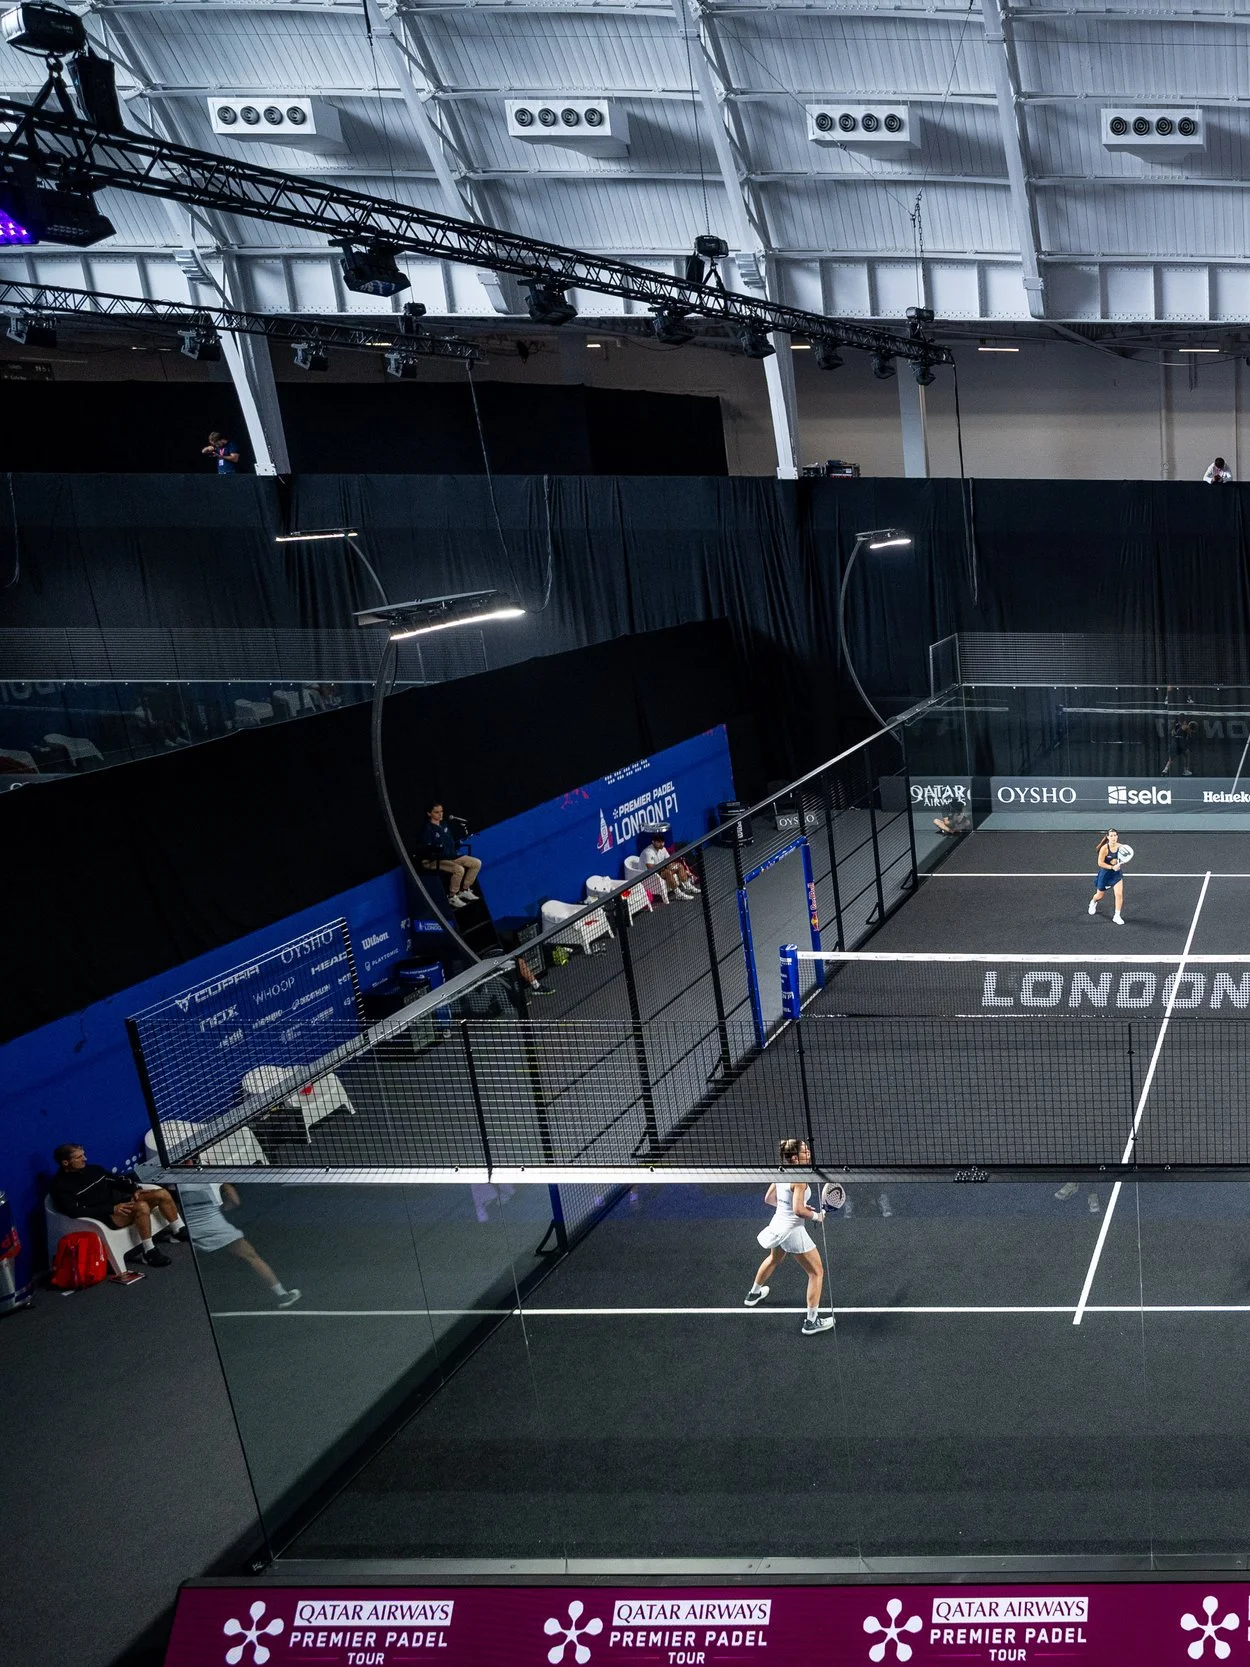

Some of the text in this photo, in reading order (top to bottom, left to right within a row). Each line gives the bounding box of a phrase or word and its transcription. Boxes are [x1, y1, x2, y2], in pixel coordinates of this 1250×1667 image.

[619, 781, 675, 817] PREMIER PADEL
[997, 786, 1077, 804] OYSHO
[1128, 786, 1172, 805] sela
[614, 793, 679, 845] LONDON P1
[779, 814, 815, 827] OYSO
[281, 928, 333, 964] OYSHO
[361, 932, 389, 950] Wilson
[310, 951, 348, 975] HEAD
[372, 948, 399, 966] PLAYTOMIC
[195, 964, 260, 1003] CUPRA
[253, 976, 295, 1005] WHOOP
[299, 1604, 450, 1623] QATAR AIRWAYS
[617, 1603, 767, 1624] QATAR AIRWAYS
[936, 1600, 1085, 1621] QATAR AIRWAYS
[289, 1631, 448, 1648] PREMIER PADEL
[609, 1630, 767, 1647] PREMIER PADEL
[930, 1627, 1087, 1645] PREMIER PADEL
[347, 1652, 385, 1665] TOUR
[668, 1651, 706, 1665] TOUR
[989, 1649, 1027, 1662] TOUR
